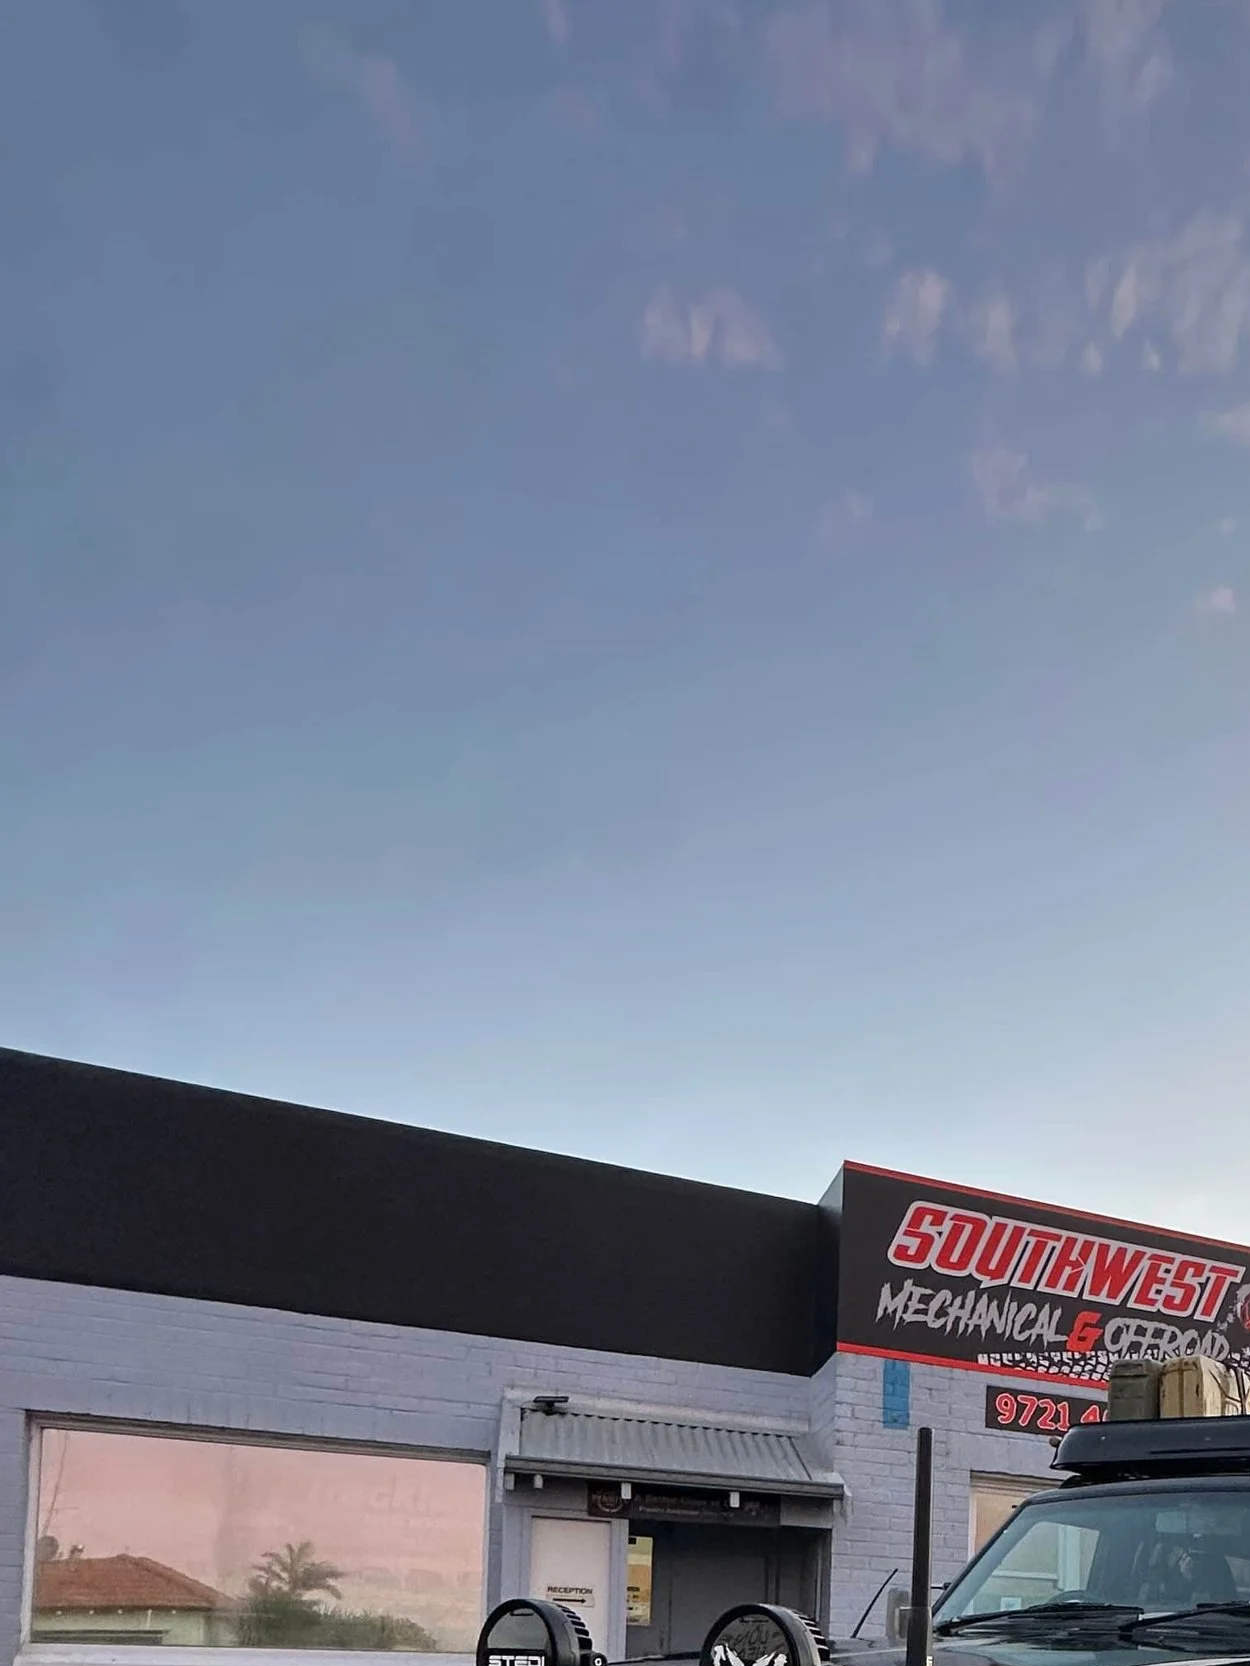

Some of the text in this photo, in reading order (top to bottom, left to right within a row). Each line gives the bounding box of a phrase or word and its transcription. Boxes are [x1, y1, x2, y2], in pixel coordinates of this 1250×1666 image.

[887, 1200, 1246, 1323] SOUTHWEST
[875, 1279, 1068, 1352] MECHANICAL
[1104, 1317, 1230, 1361] OFFROAD
[995, 1393, 1070, 1431] 9721
[547, 1586, 593, 1595] RECEPTION
